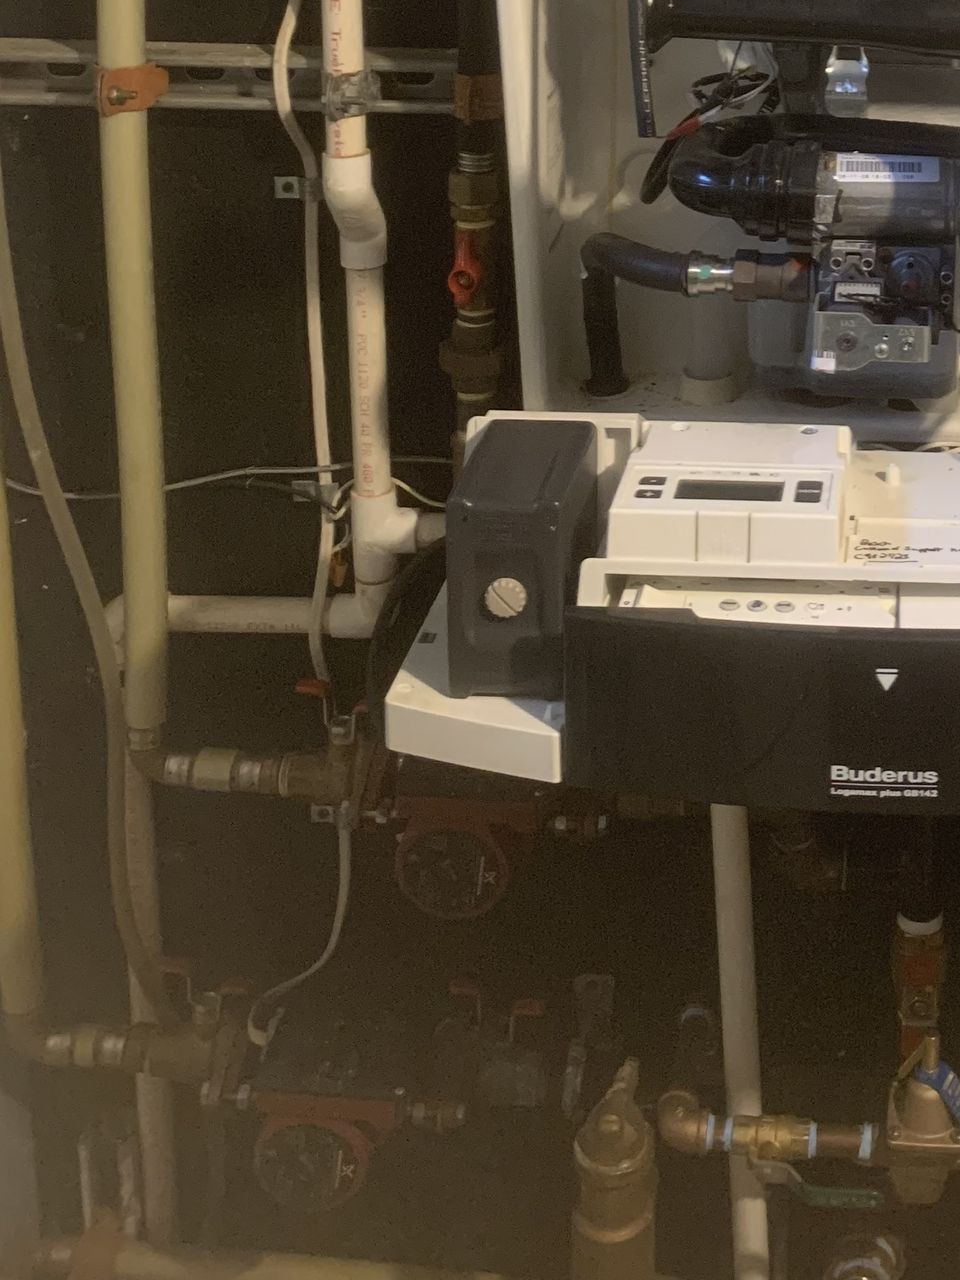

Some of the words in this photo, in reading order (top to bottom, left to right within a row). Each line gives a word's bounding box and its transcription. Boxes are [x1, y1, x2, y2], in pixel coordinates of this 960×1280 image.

[830, 765, 939, 783] Buderus
[830, 787, 878, 797] Logamax
[879, 789, 902, 798] plus
[903, 789, 938, 798] GB142
